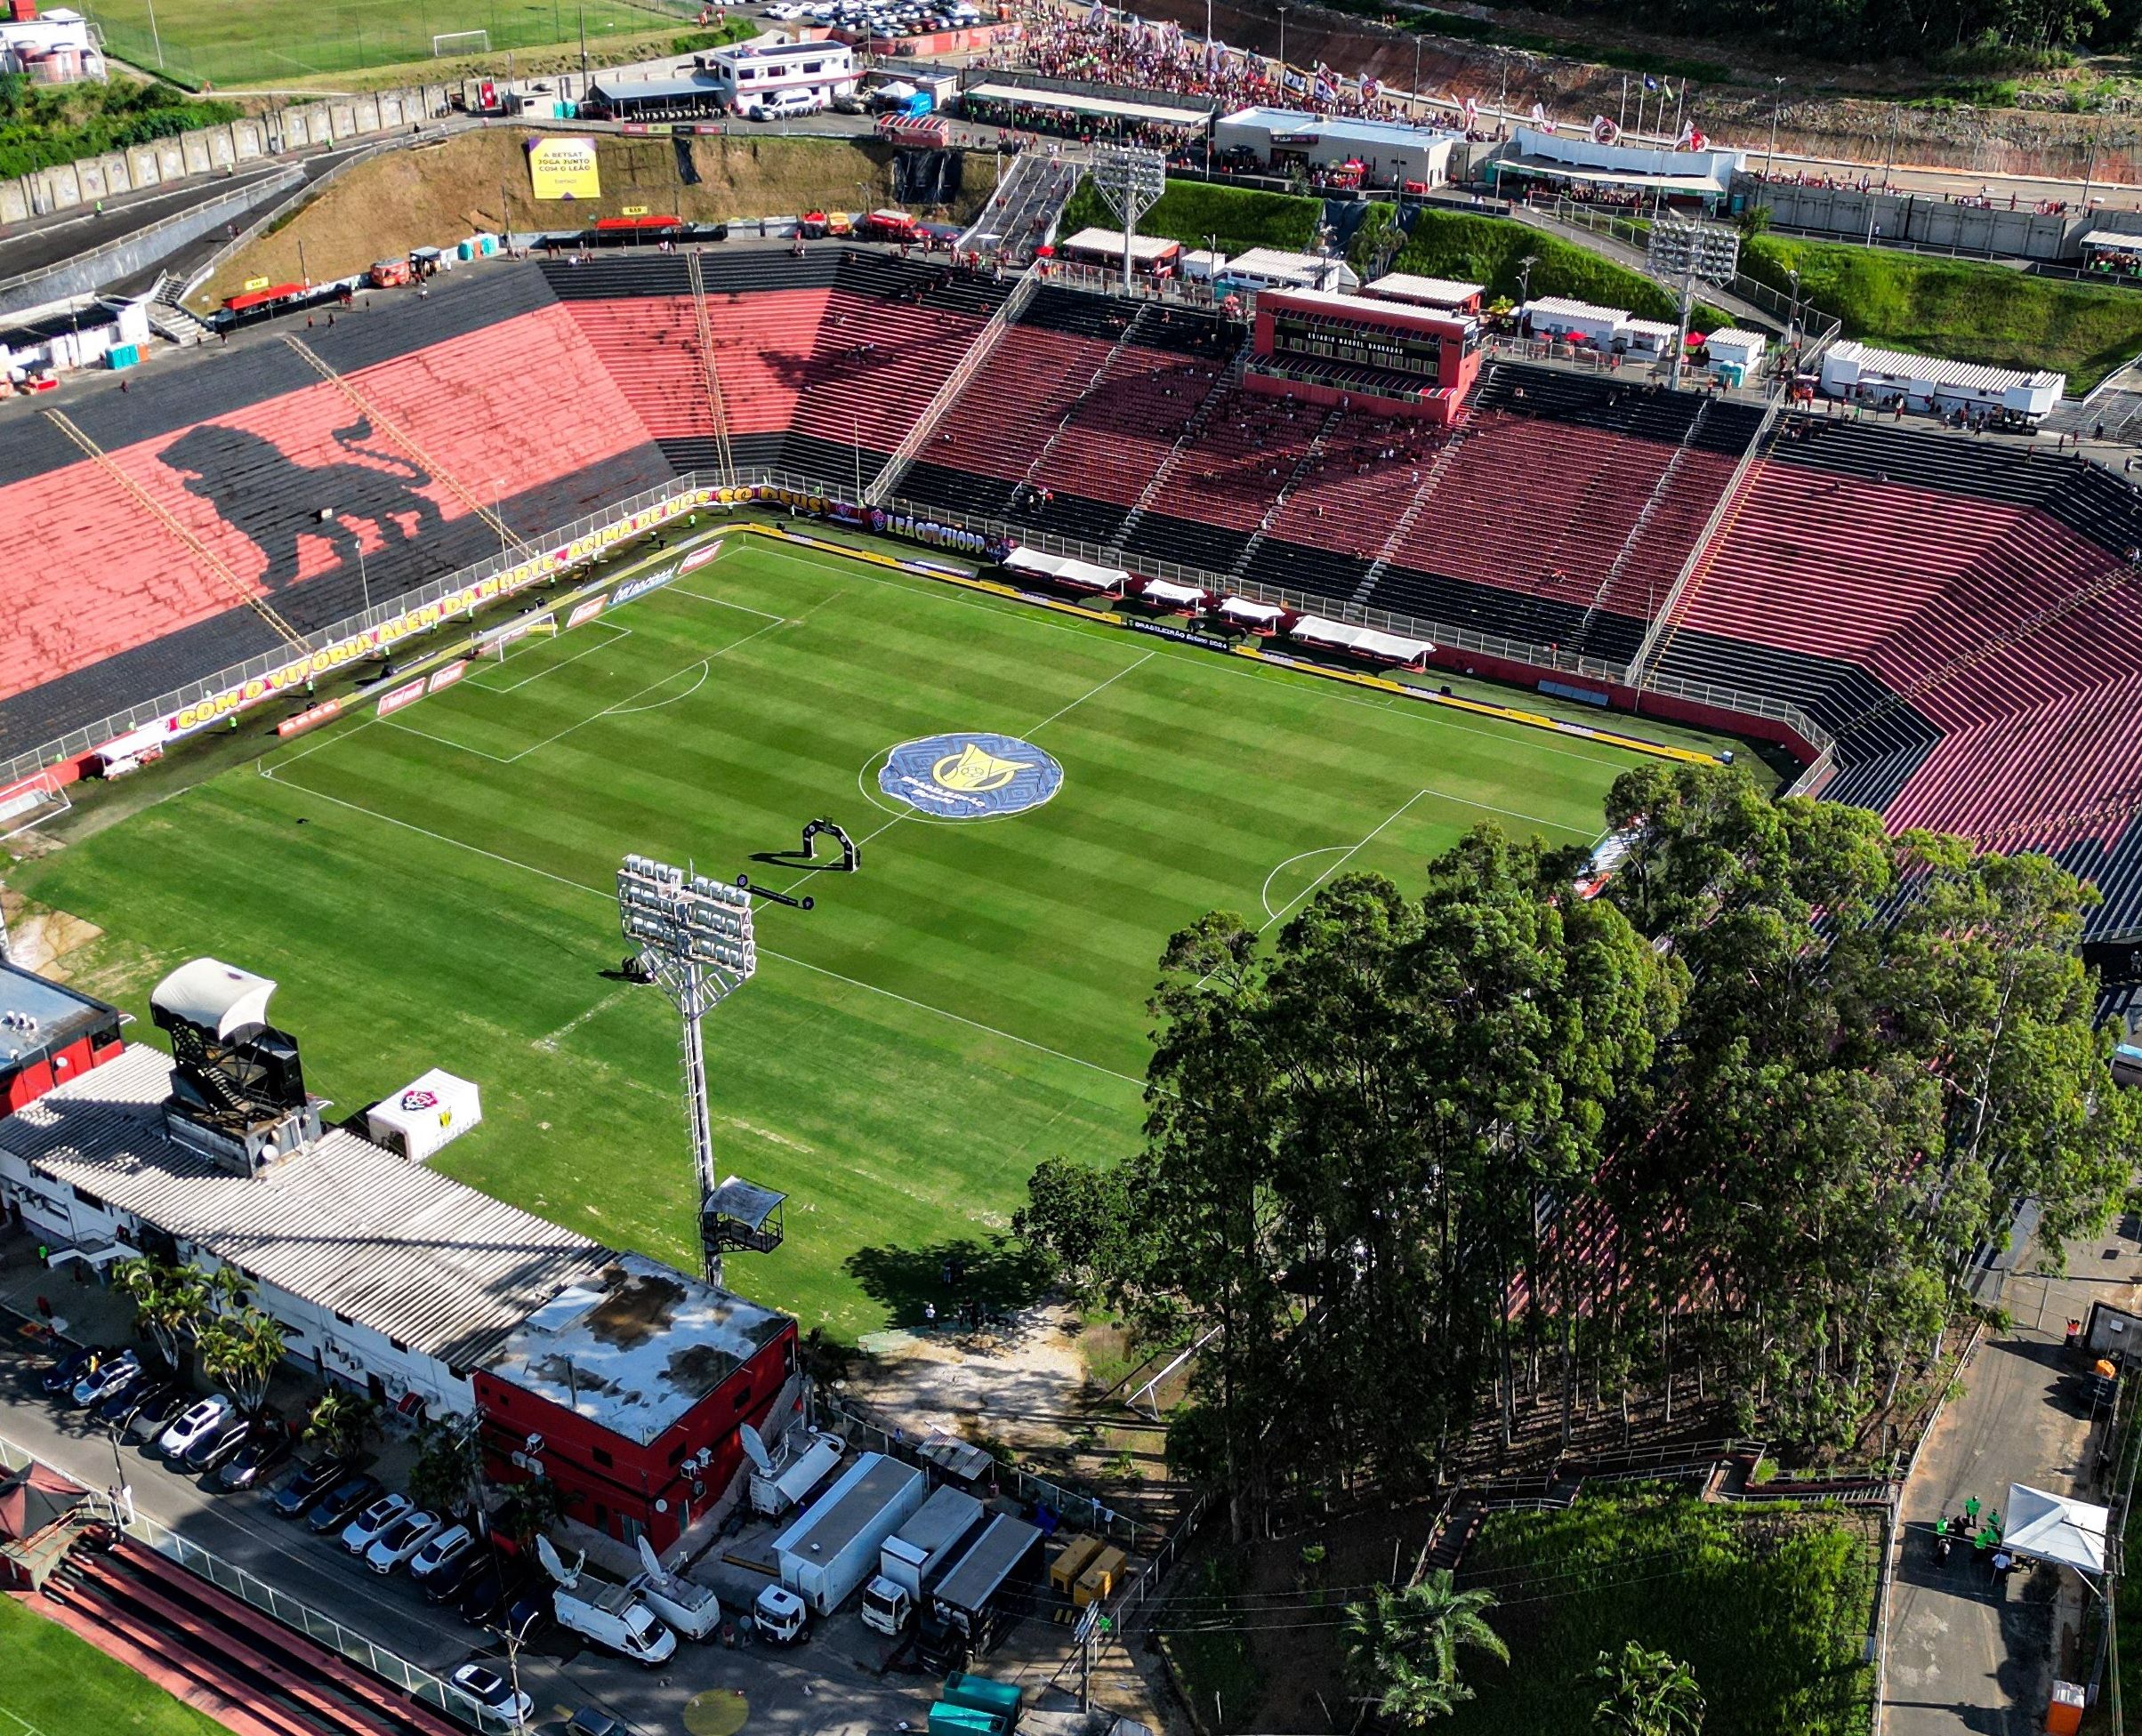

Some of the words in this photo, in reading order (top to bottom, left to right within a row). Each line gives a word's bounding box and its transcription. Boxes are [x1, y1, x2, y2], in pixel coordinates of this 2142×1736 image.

[886, 514, 927, 541] LEÃO
[938, 526, 986, 554] CHOPP
[178, 690, 240, 729] COM
[244, 679, 264, 699] O
[379, 604, 441, 644] ALÉM
[444, 588, 477, 615] DA
[568, 518, 632, 560] ACIMA
[636, 506, 662, 529] DE
[759, 486, 831, 515] DEUS!
[1134, 622, 1186, 639] BRASILEIRÃO
[1209, 639, 1228, 649] 2024
